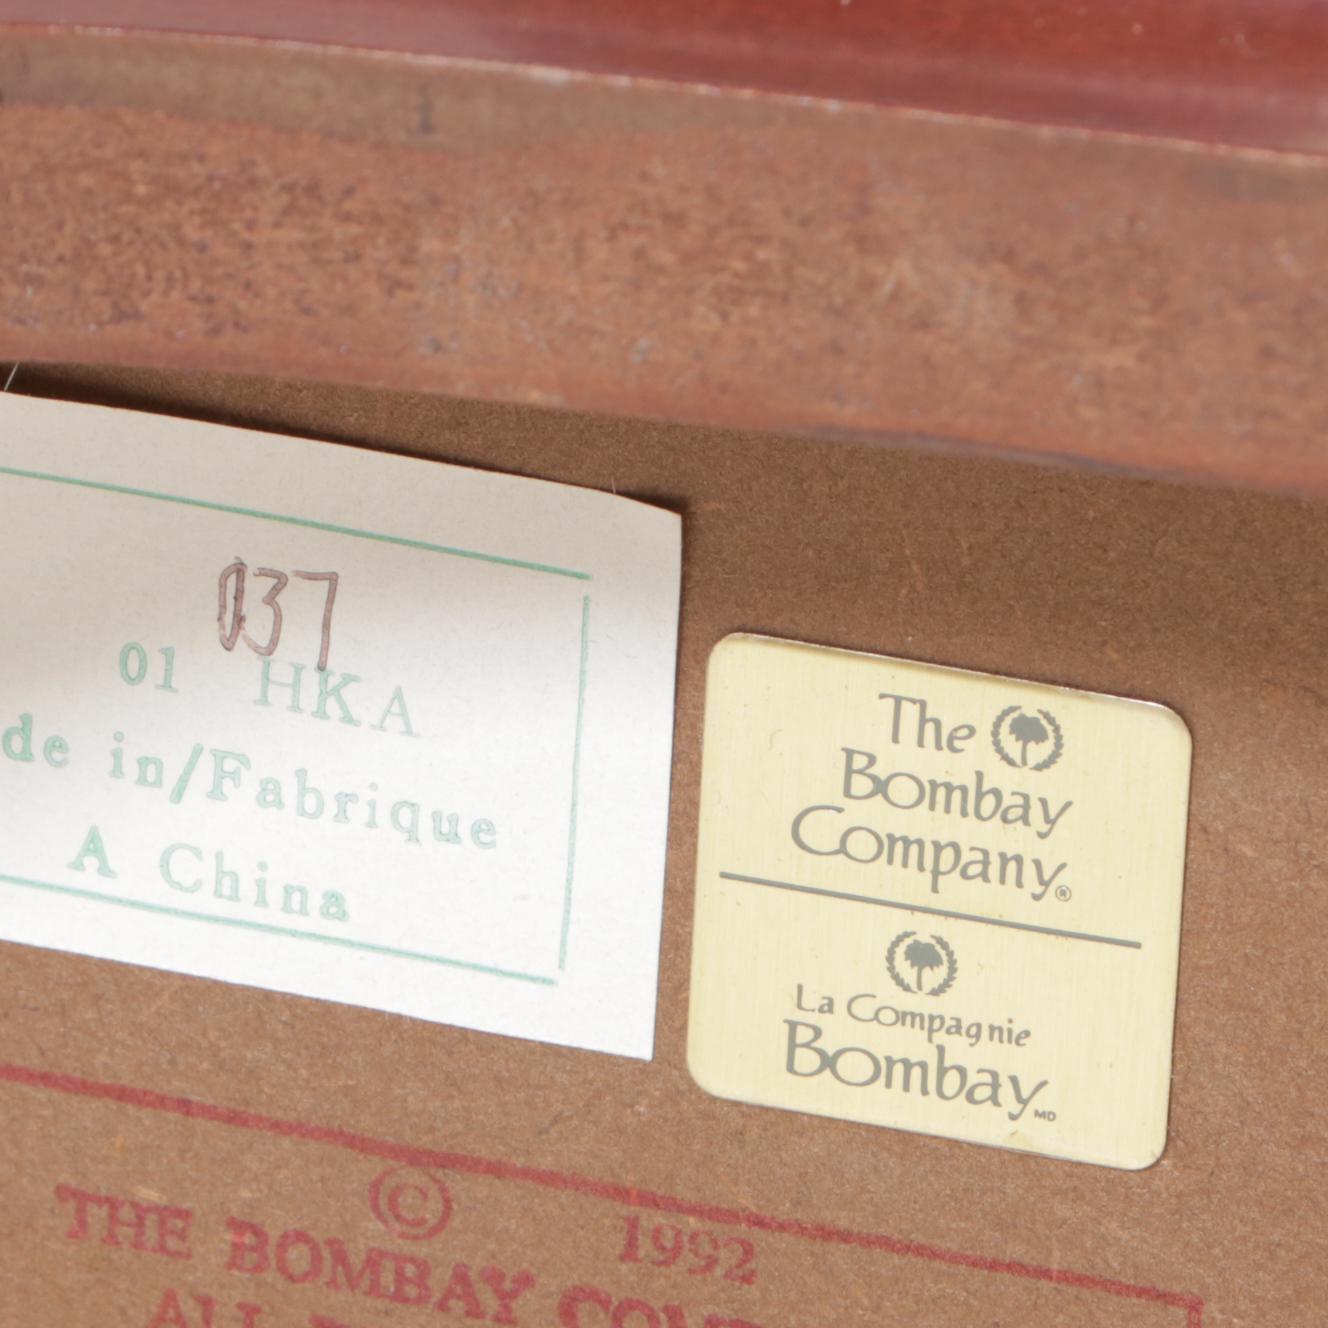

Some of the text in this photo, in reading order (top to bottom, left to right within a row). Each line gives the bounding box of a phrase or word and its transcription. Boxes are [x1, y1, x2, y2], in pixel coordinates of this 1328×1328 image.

[119, 642, 421, 738] 01 HKA
[878, 692, 976, 754] The
[109, 732, 498, 850] in/Fabrique
[840, 747, 1073, 839] Bombay
[69, 827, 350, 923] A China
[796, 983, 1031, 1047] La Compagnie
[782, 1018, 1049, 1120] Bombay
[55, 1183, 194, 1260] THE
[225, 1216, 537, 1327] BOMBAY
[617, 1214, 759, 1286] 1992
